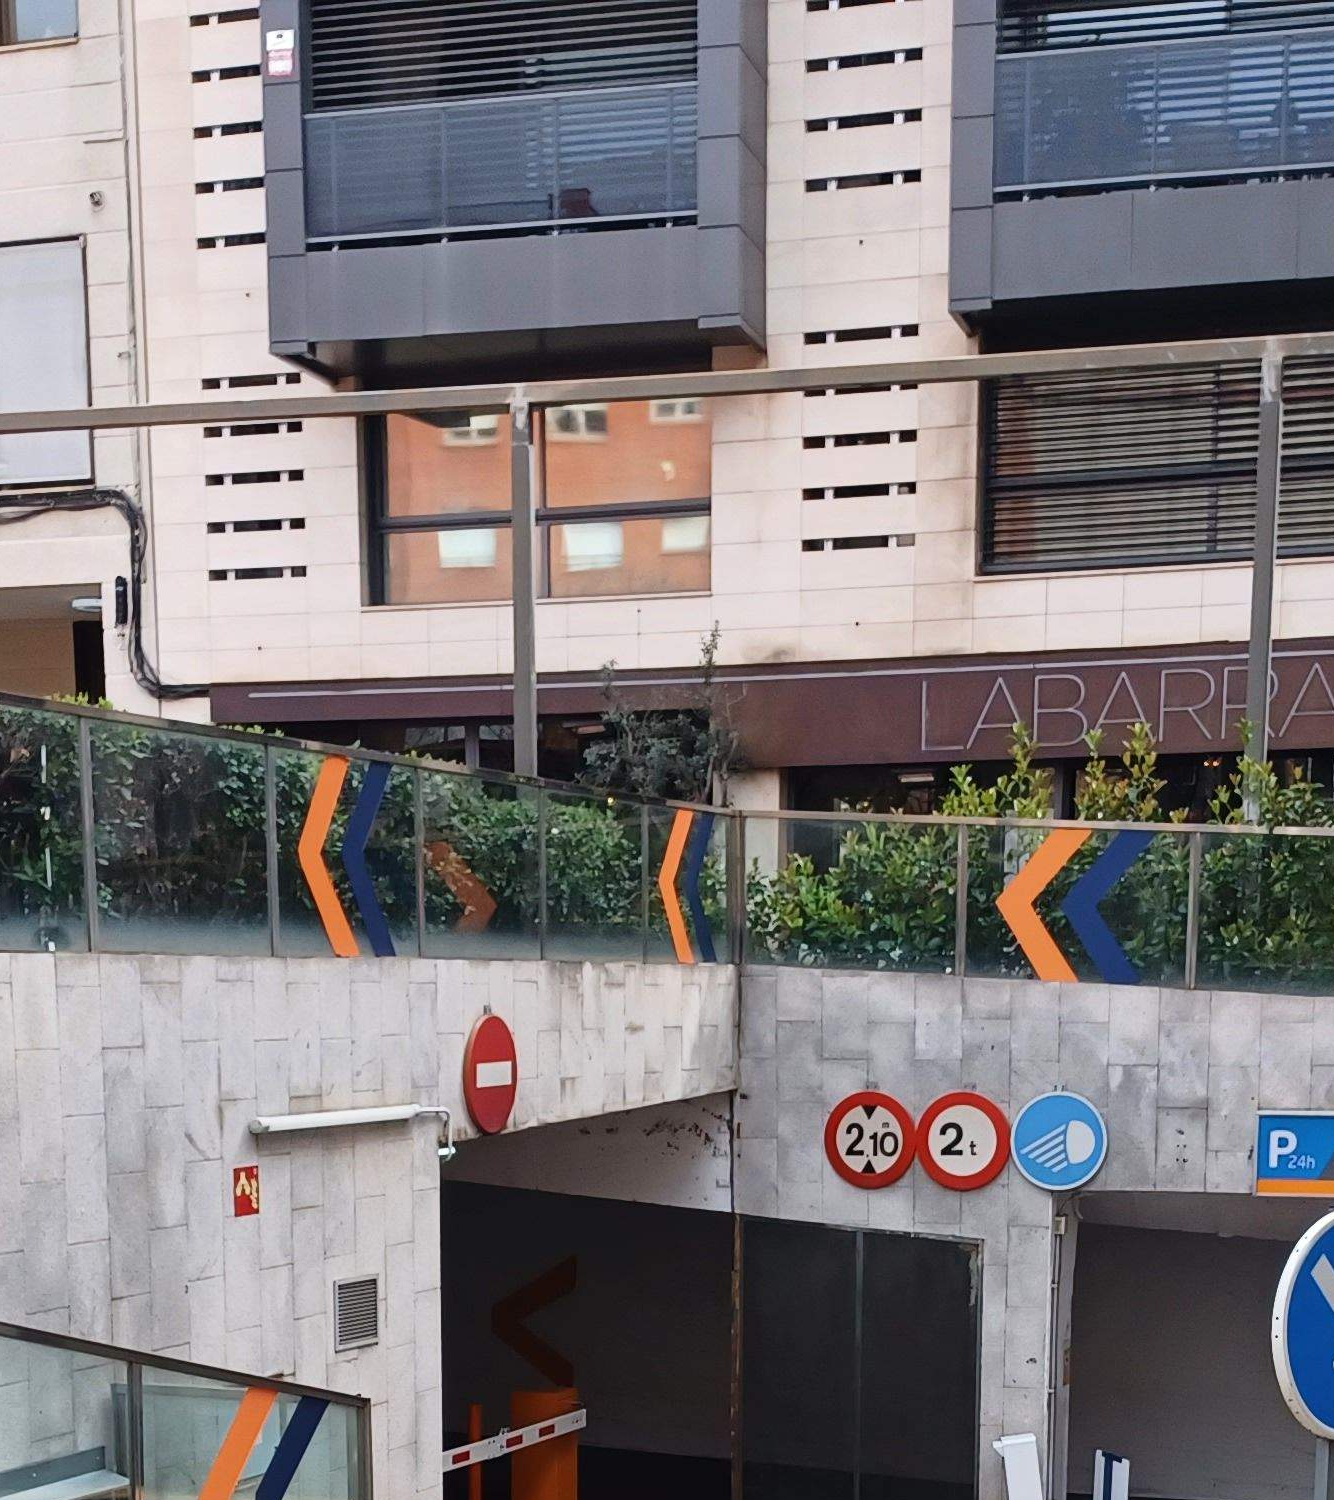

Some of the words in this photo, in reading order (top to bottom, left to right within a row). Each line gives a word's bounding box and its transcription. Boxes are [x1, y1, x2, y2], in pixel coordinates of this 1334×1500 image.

[939, 1122, 964, 1156] 2
[969, 1139, 977, 1156] t
[1269, 1129, 1297, 1168] P
[1288, 1153, 1316, 1169] 24h
